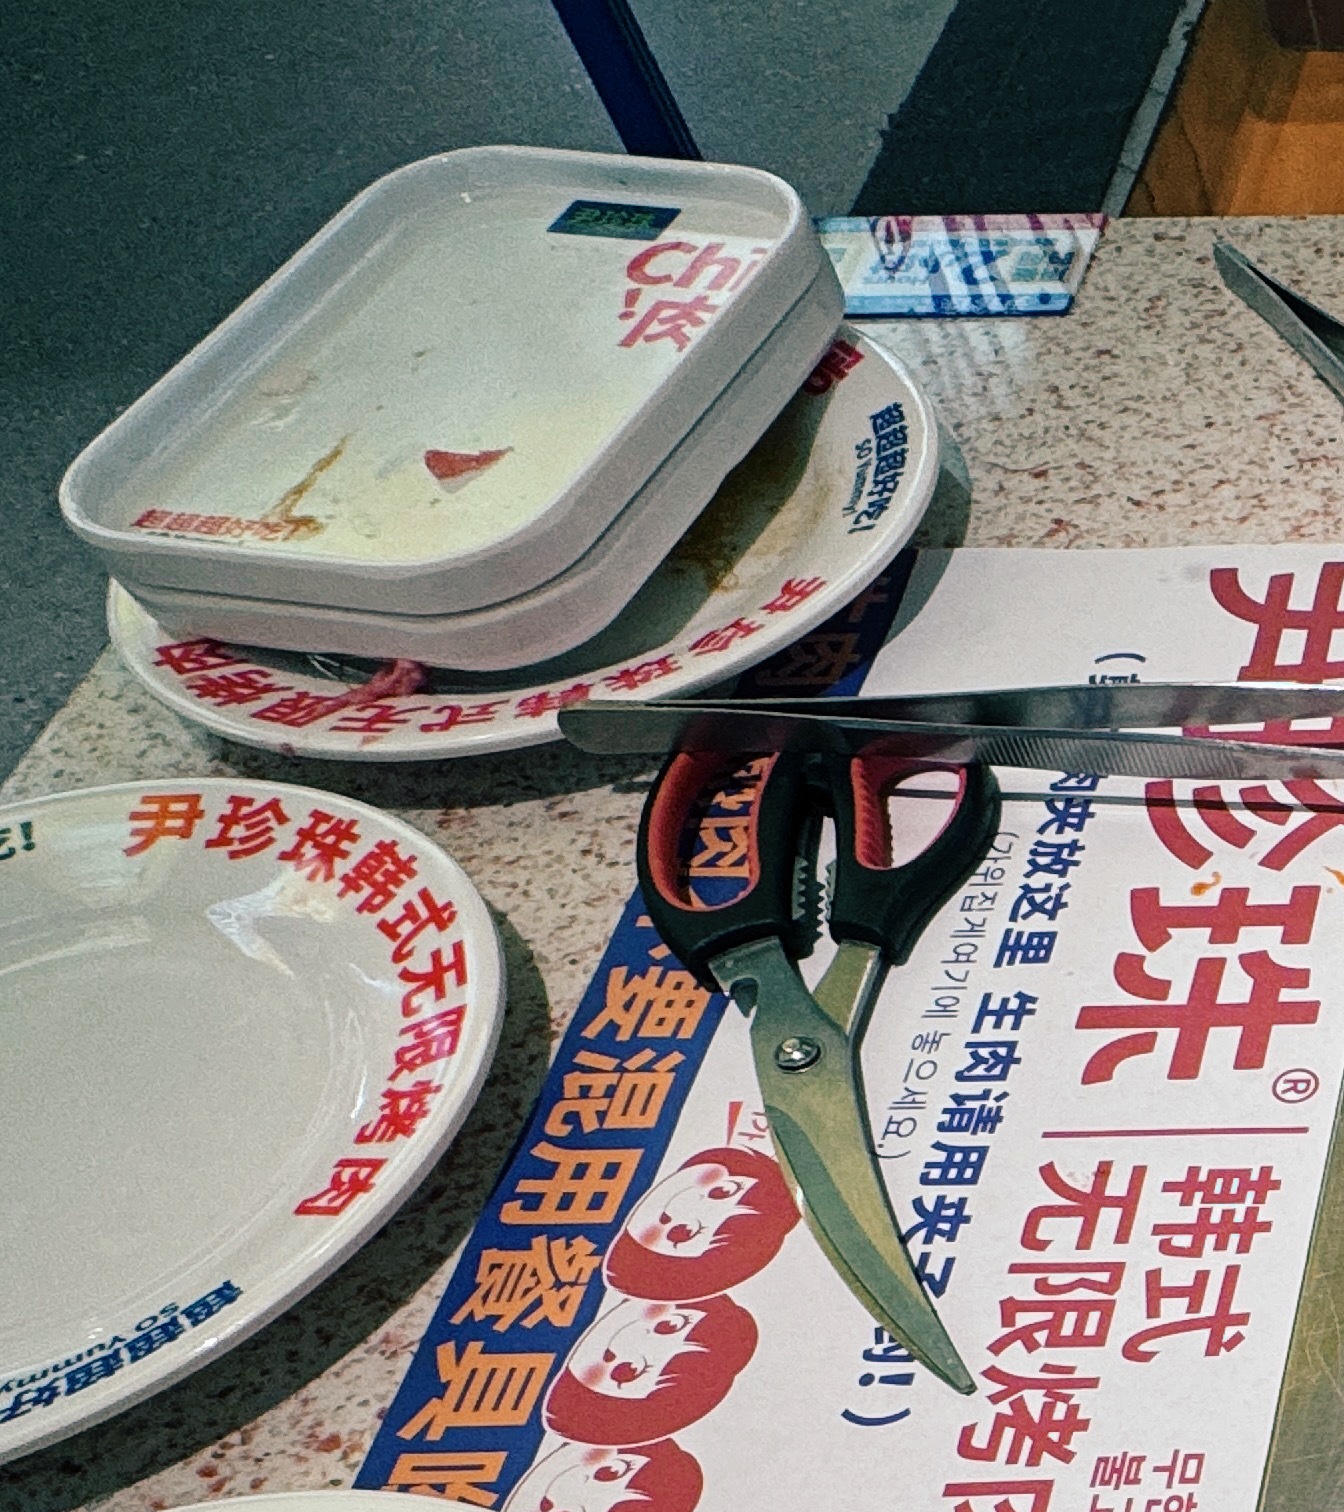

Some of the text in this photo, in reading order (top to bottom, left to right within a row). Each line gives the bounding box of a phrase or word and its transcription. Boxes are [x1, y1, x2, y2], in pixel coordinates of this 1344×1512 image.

[124, 793, 467, 1217] 尹珍珠韩式无限烤肉
[1120, 1161, 1281, 1364] 韩式
